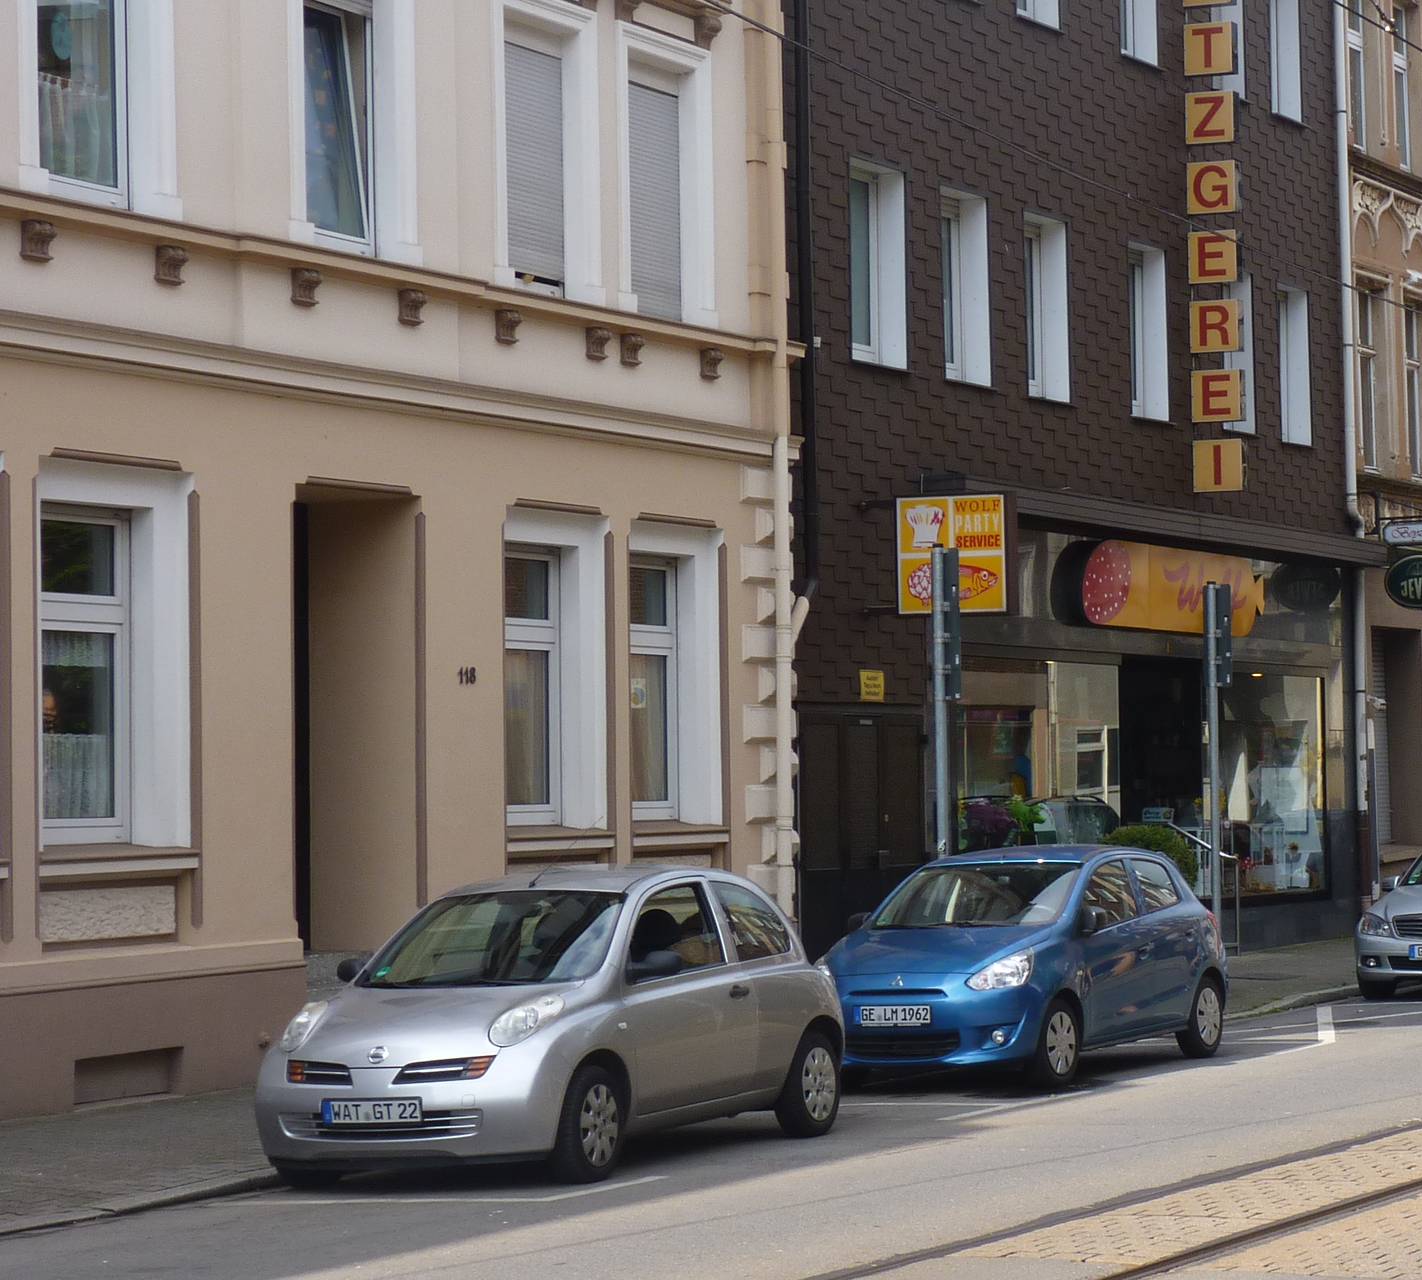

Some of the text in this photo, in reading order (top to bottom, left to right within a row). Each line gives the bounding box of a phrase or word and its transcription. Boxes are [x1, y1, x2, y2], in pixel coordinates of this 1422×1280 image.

[955, 500, 1001, 513] WOLF
[956, 513, 1000, 534] PARTY
[956, 534, 1001, 549] SERVICE
[457, 666, 477, 685] 118
[861, 1007, 929, 1022] GE LM 1962
[332, 1102, 419, 1122] WAT GT 22
